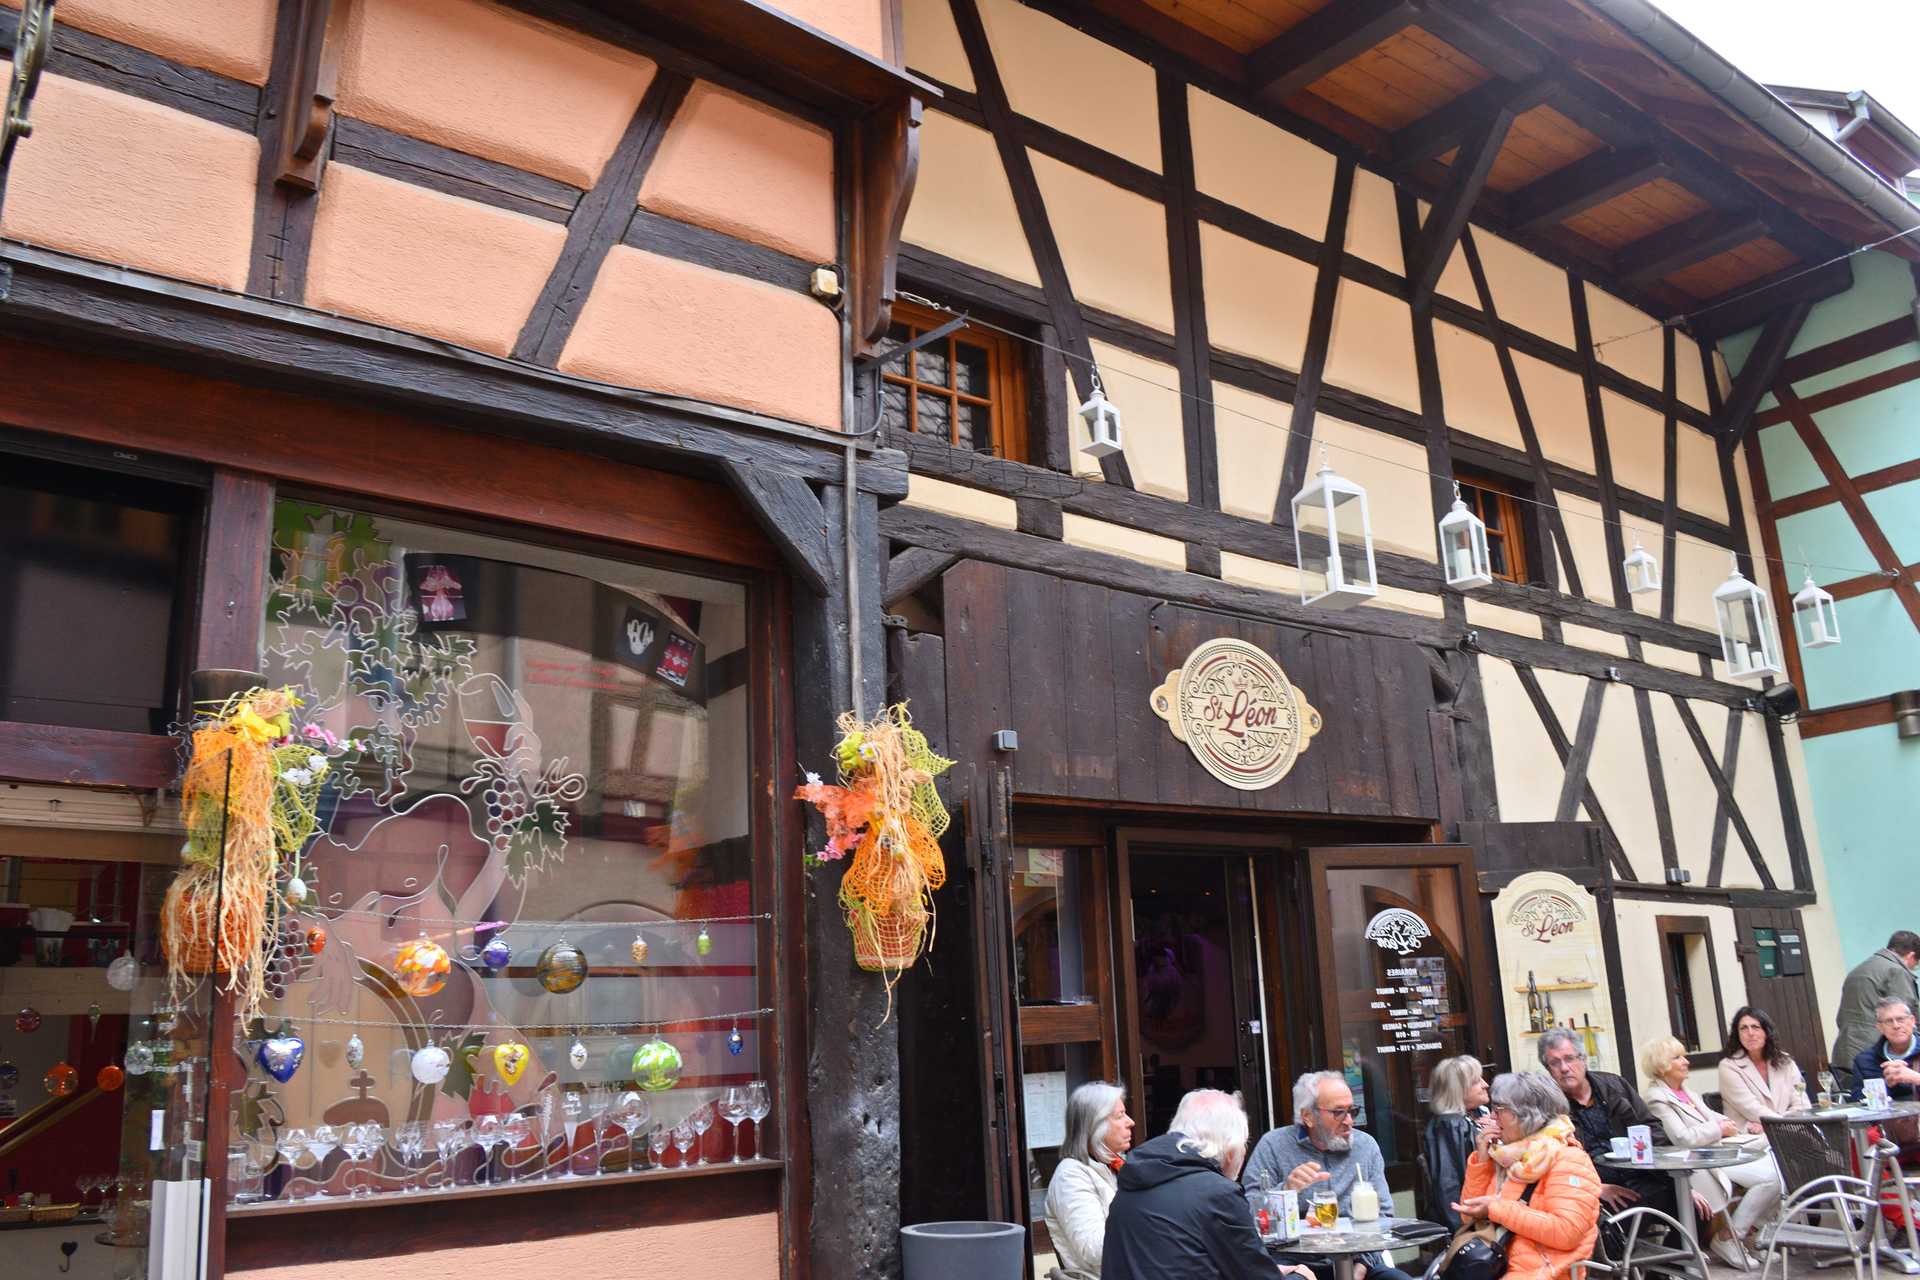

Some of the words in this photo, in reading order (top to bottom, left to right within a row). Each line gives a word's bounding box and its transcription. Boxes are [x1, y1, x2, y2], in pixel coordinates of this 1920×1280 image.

[1203, 695, 1222, 721] St
[1218, 690, 1278, 738] Léon
[1521, 920, 1535, 938] St
[1533, 914, 1575, 943] Léon
